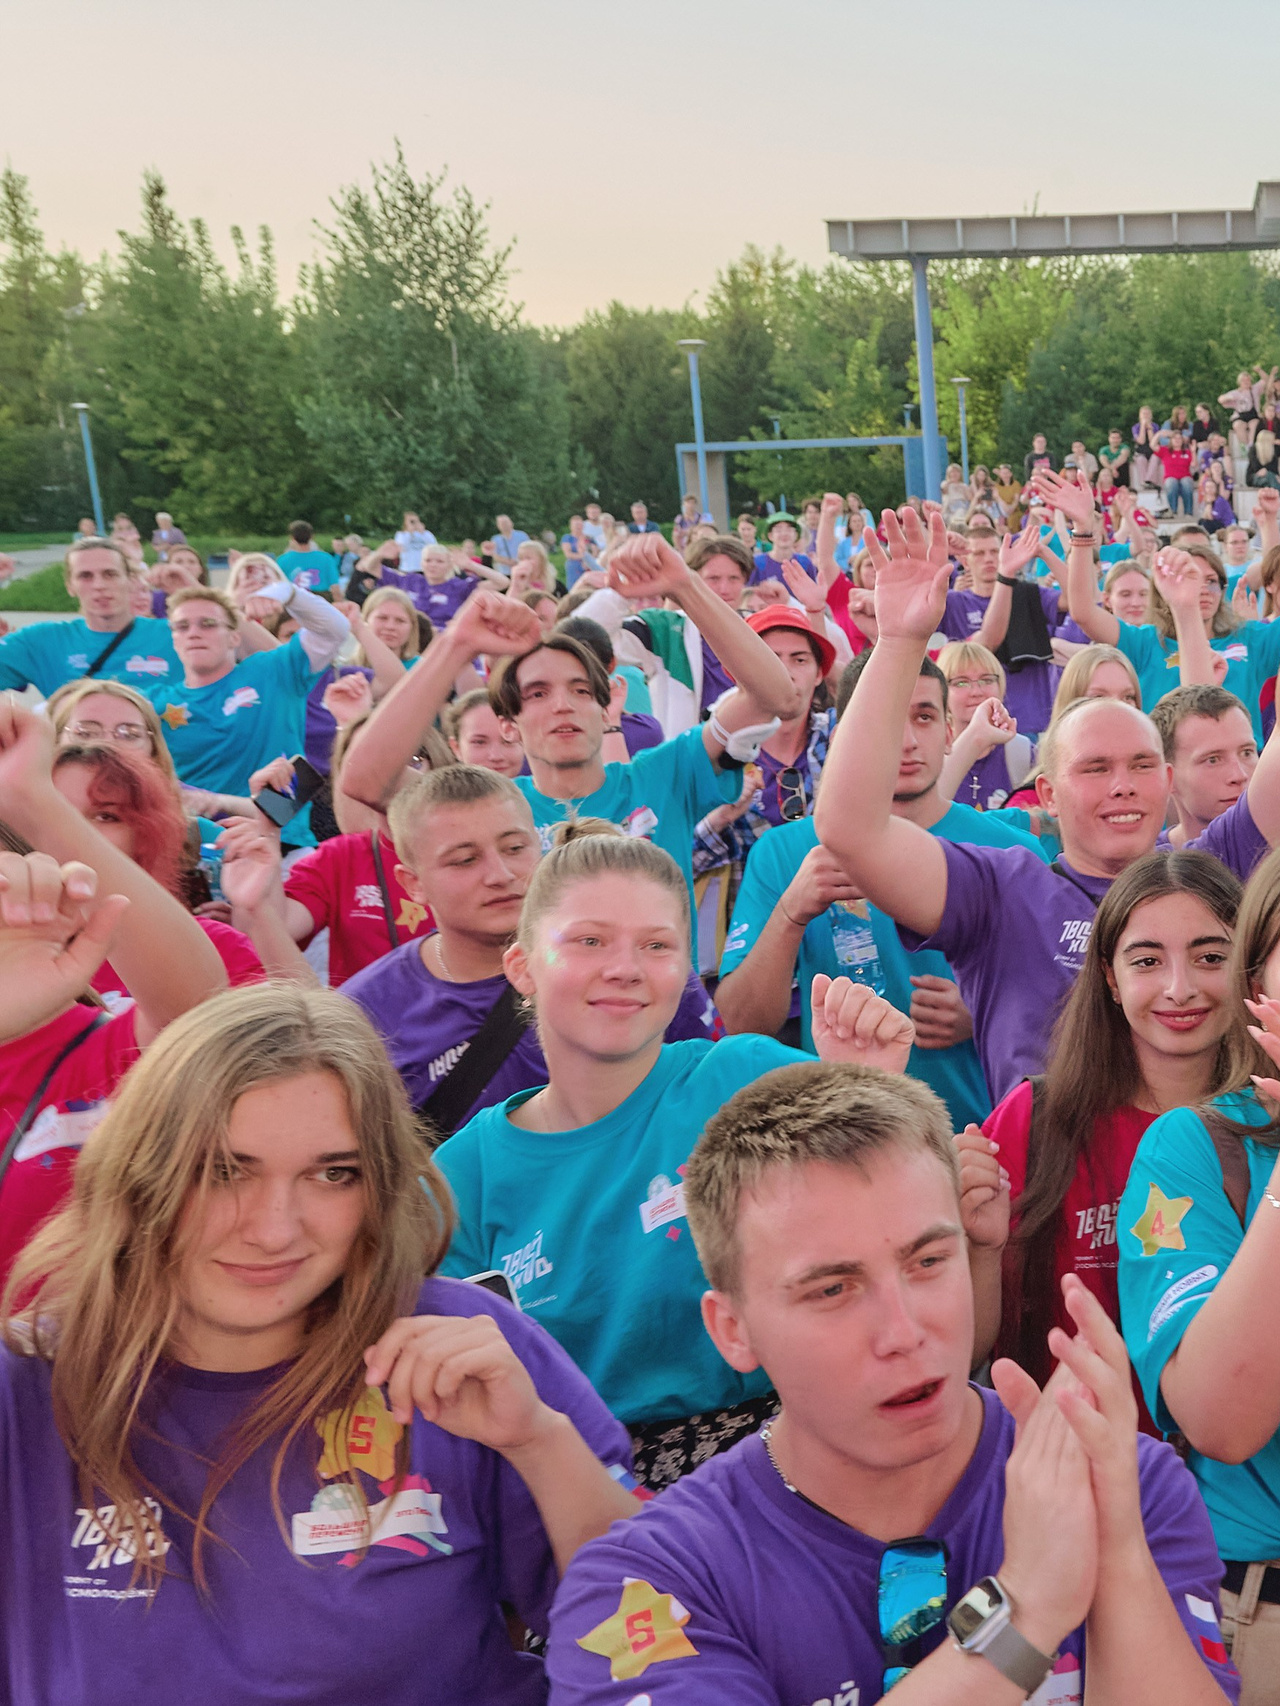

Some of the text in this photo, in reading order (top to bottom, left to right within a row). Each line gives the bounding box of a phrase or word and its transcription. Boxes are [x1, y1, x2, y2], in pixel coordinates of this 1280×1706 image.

[1060, 920, 1093, 943] ТВО
[1150, 1210, 1165, 1236] 4
[349, 1414, 377, 1455] 5
[625, 1609, 656, 1654] 5
